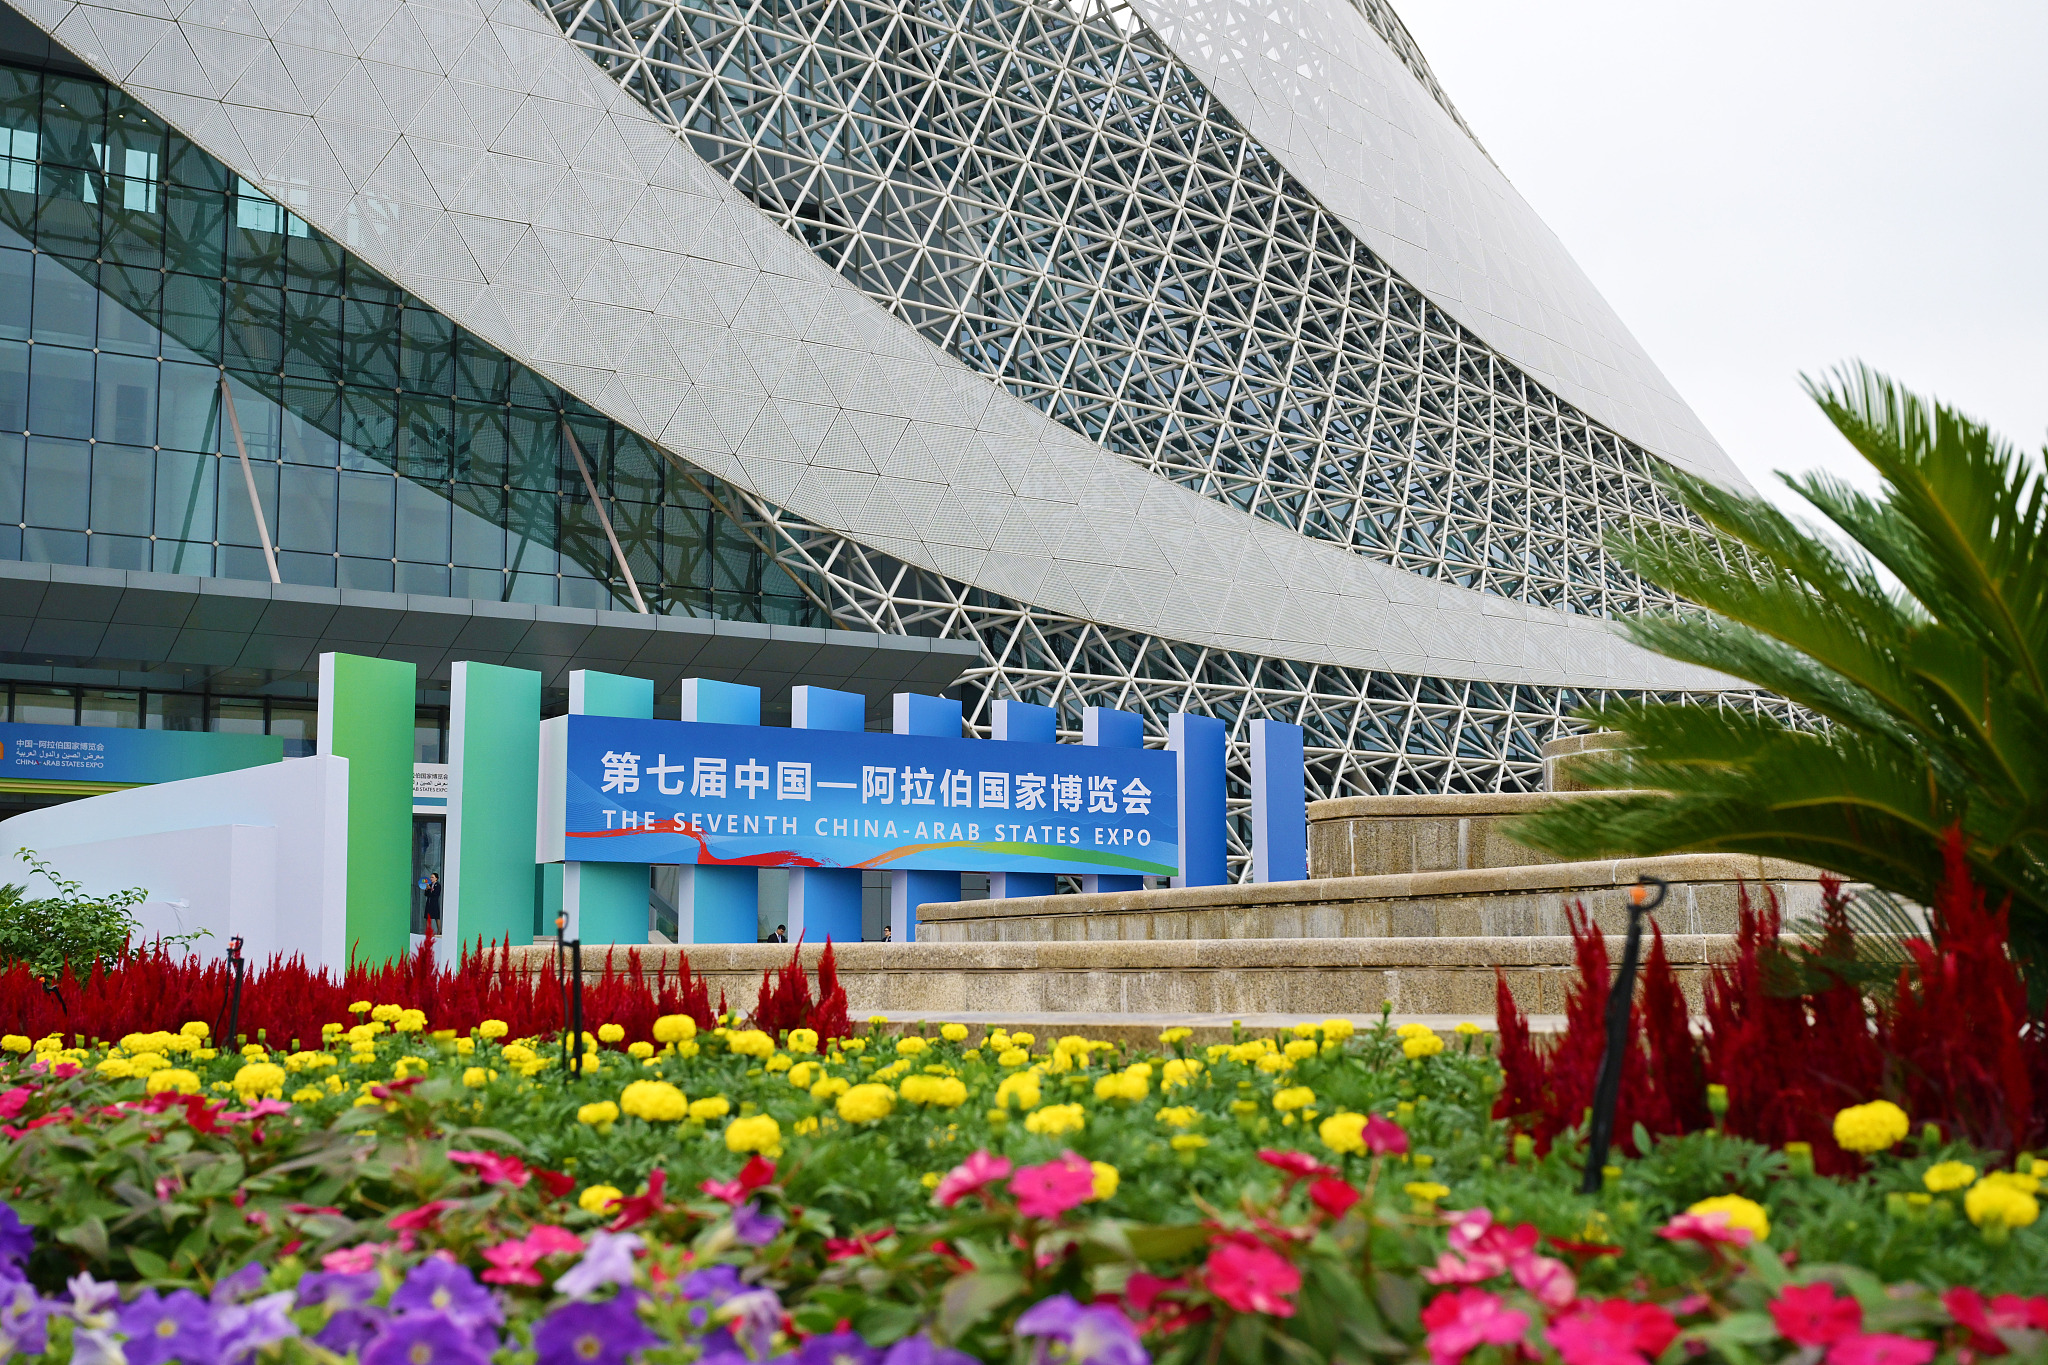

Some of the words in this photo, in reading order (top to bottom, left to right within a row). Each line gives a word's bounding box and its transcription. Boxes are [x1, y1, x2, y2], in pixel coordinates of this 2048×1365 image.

[603, 809, 655, 831] THE
[673, 812, 797, 835] SEVENTH
[815, 817, 980, 841] CHINA-ARAB
[995, 824, 1080, 845] STATES
[1095, 827, 1152, 847] EXPO
